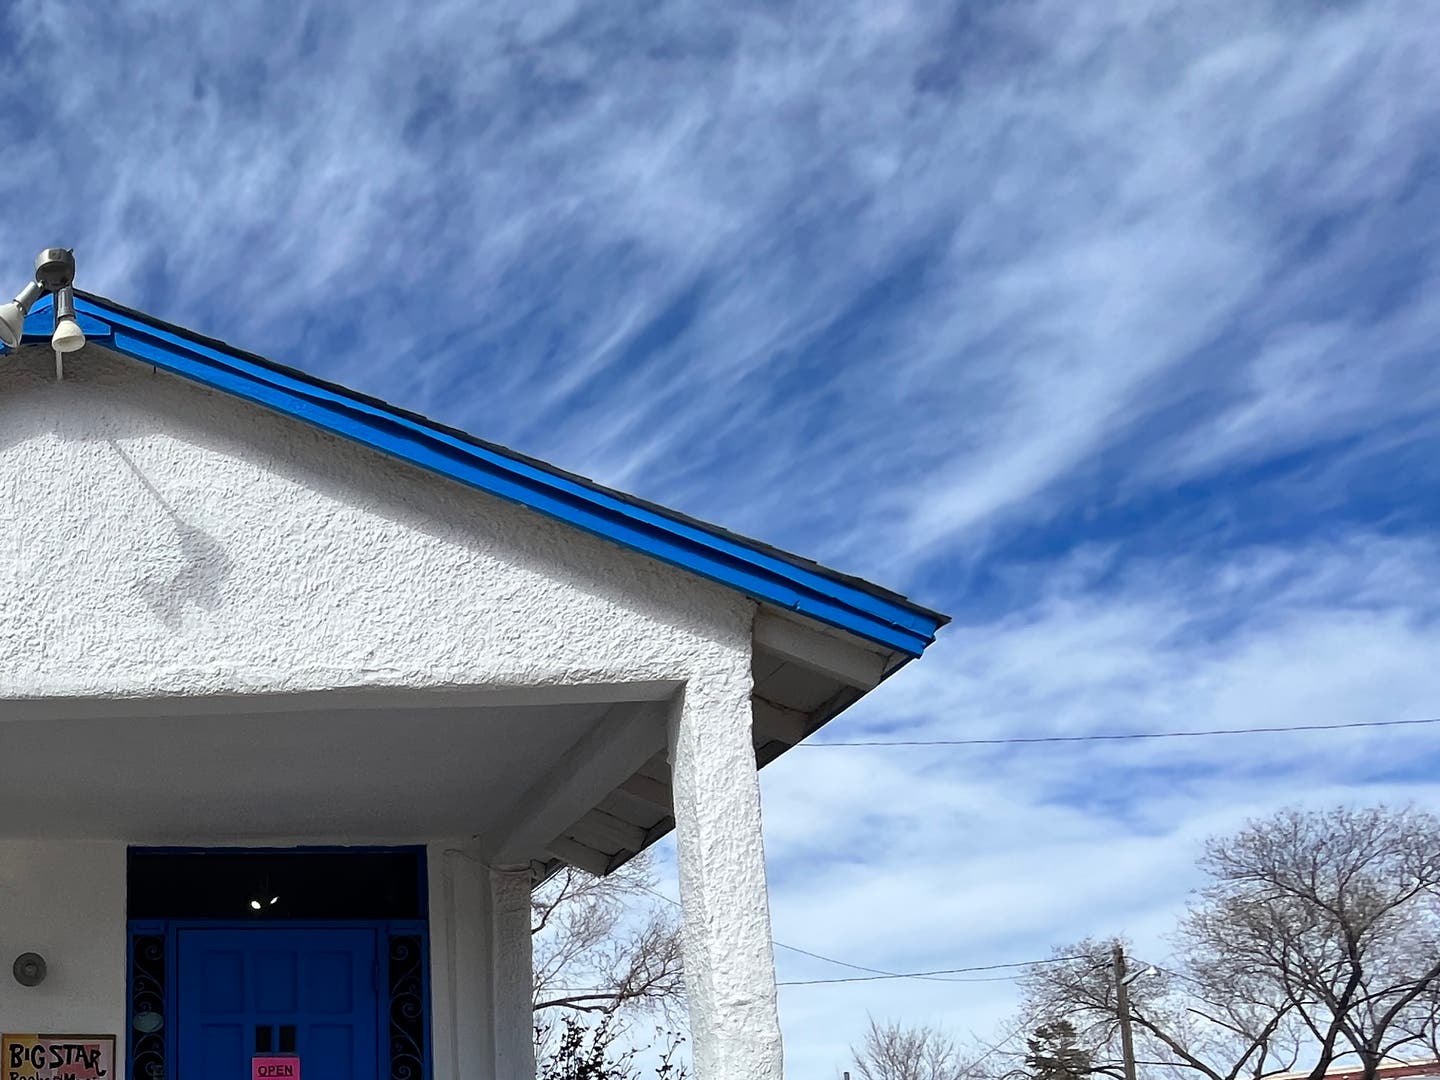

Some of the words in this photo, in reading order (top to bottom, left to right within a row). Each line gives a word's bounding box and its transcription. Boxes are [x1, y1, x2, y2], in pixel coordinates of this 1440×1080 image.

[9, 1044, 46, 1069] BIG
[49, 1044, 107, 1076] STAR
[258, 1065, 293, 1077] OPEN
